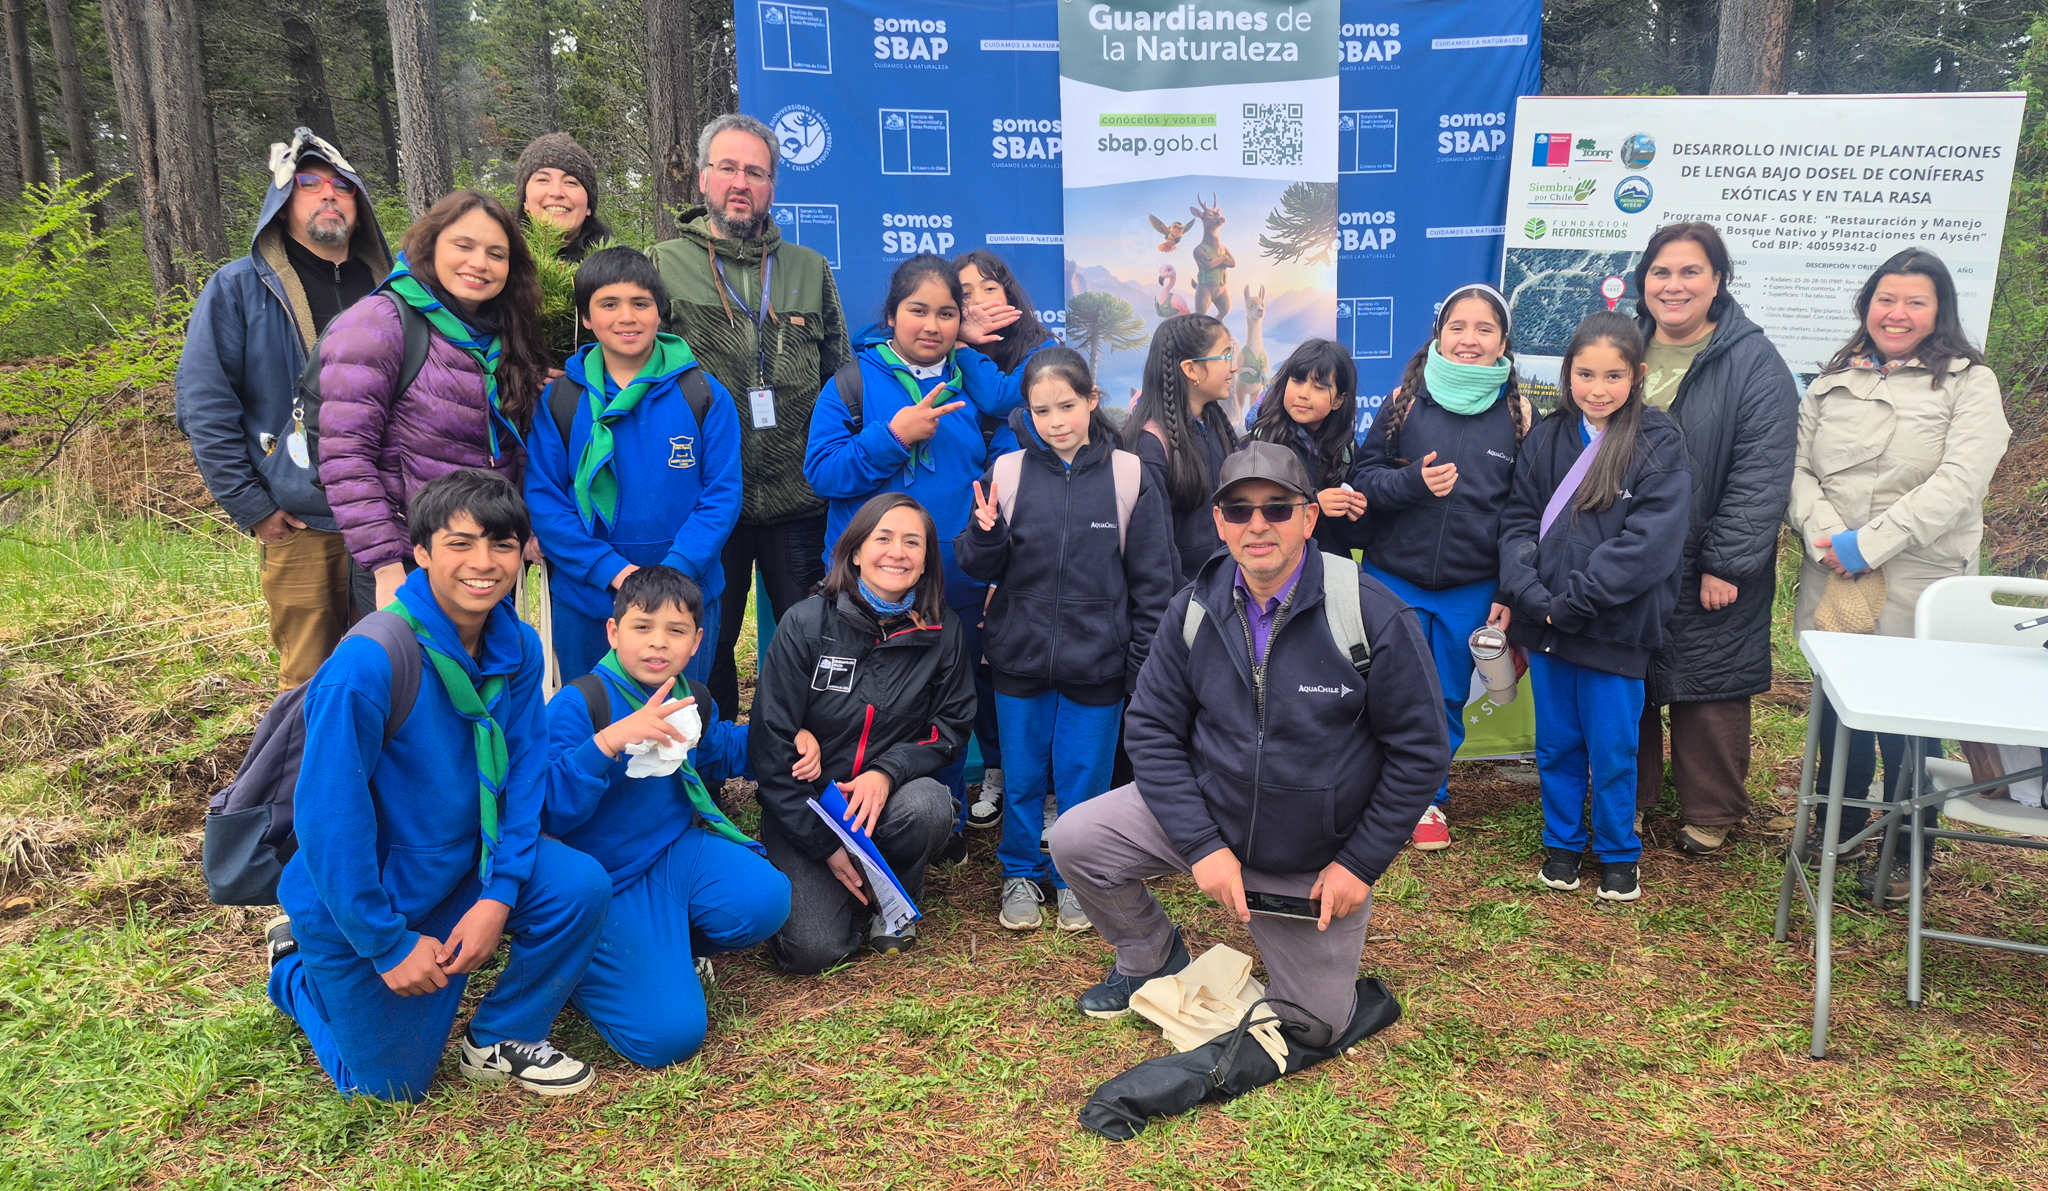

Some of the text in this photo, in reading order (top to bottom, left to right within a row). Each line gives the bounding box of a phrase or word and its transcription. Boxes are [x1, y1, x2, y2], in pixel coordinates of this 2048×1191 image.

[874, 18, 946, 34] somos
[1088, 4, 1312, 32] Guardianes de
[1339, 23, 1400, 37] omos
[874, 36, 948, 60] SBAP
[1102, 36, 1298, 61] la Naturaleza
[992, 118, 1062, 133] somos
[1102, 115, 1214, 126] conócelos y vota en
[1439, 112, 1506, 128] somos
[992, 136, 1062, 159] SBAP
[1098, 134, 1218, 156] sbap.gob.cl
[1438, 130, 1506, 154] SBAP
[1672, 144, 2001, 158] DESARROLLO INICIAL DE PLANTACIONES
[1681, 165, 1985, 182] DE LENGA BAJO DOSEL DE CONÍFERAS
[1529, 182, 1574, 192] Siembra
[1721, 186, 1932, 204] EXÓTICAS Y EN TALA RASA
[882, 213, 953, 228] somos
[1338, 211, 1396, 225] omos
[1663, 212, 1721, 223] Programa
[1726, 213, 1768, 223] CONAF
[1780, 214, 1817, 224] GORE:
[1921, 219, 1928, 228] y
[1933, 218, 1982, 230] Manejo
[1552, 228, 1627, 238] REFORESTEMOS
[1727, 226, 1771, 236] Bosque
[1775, 227, 1816, 237] Nativo
[1820, 229, 1828, 239] y
[1832, 229, 1916, 240] Plantaciones
[882, 230, 955, 254] SBAP
[1752, 240, 1877, 252] Cod BIP: 40059342-0
[277, 940, 294, 950] NIKE
